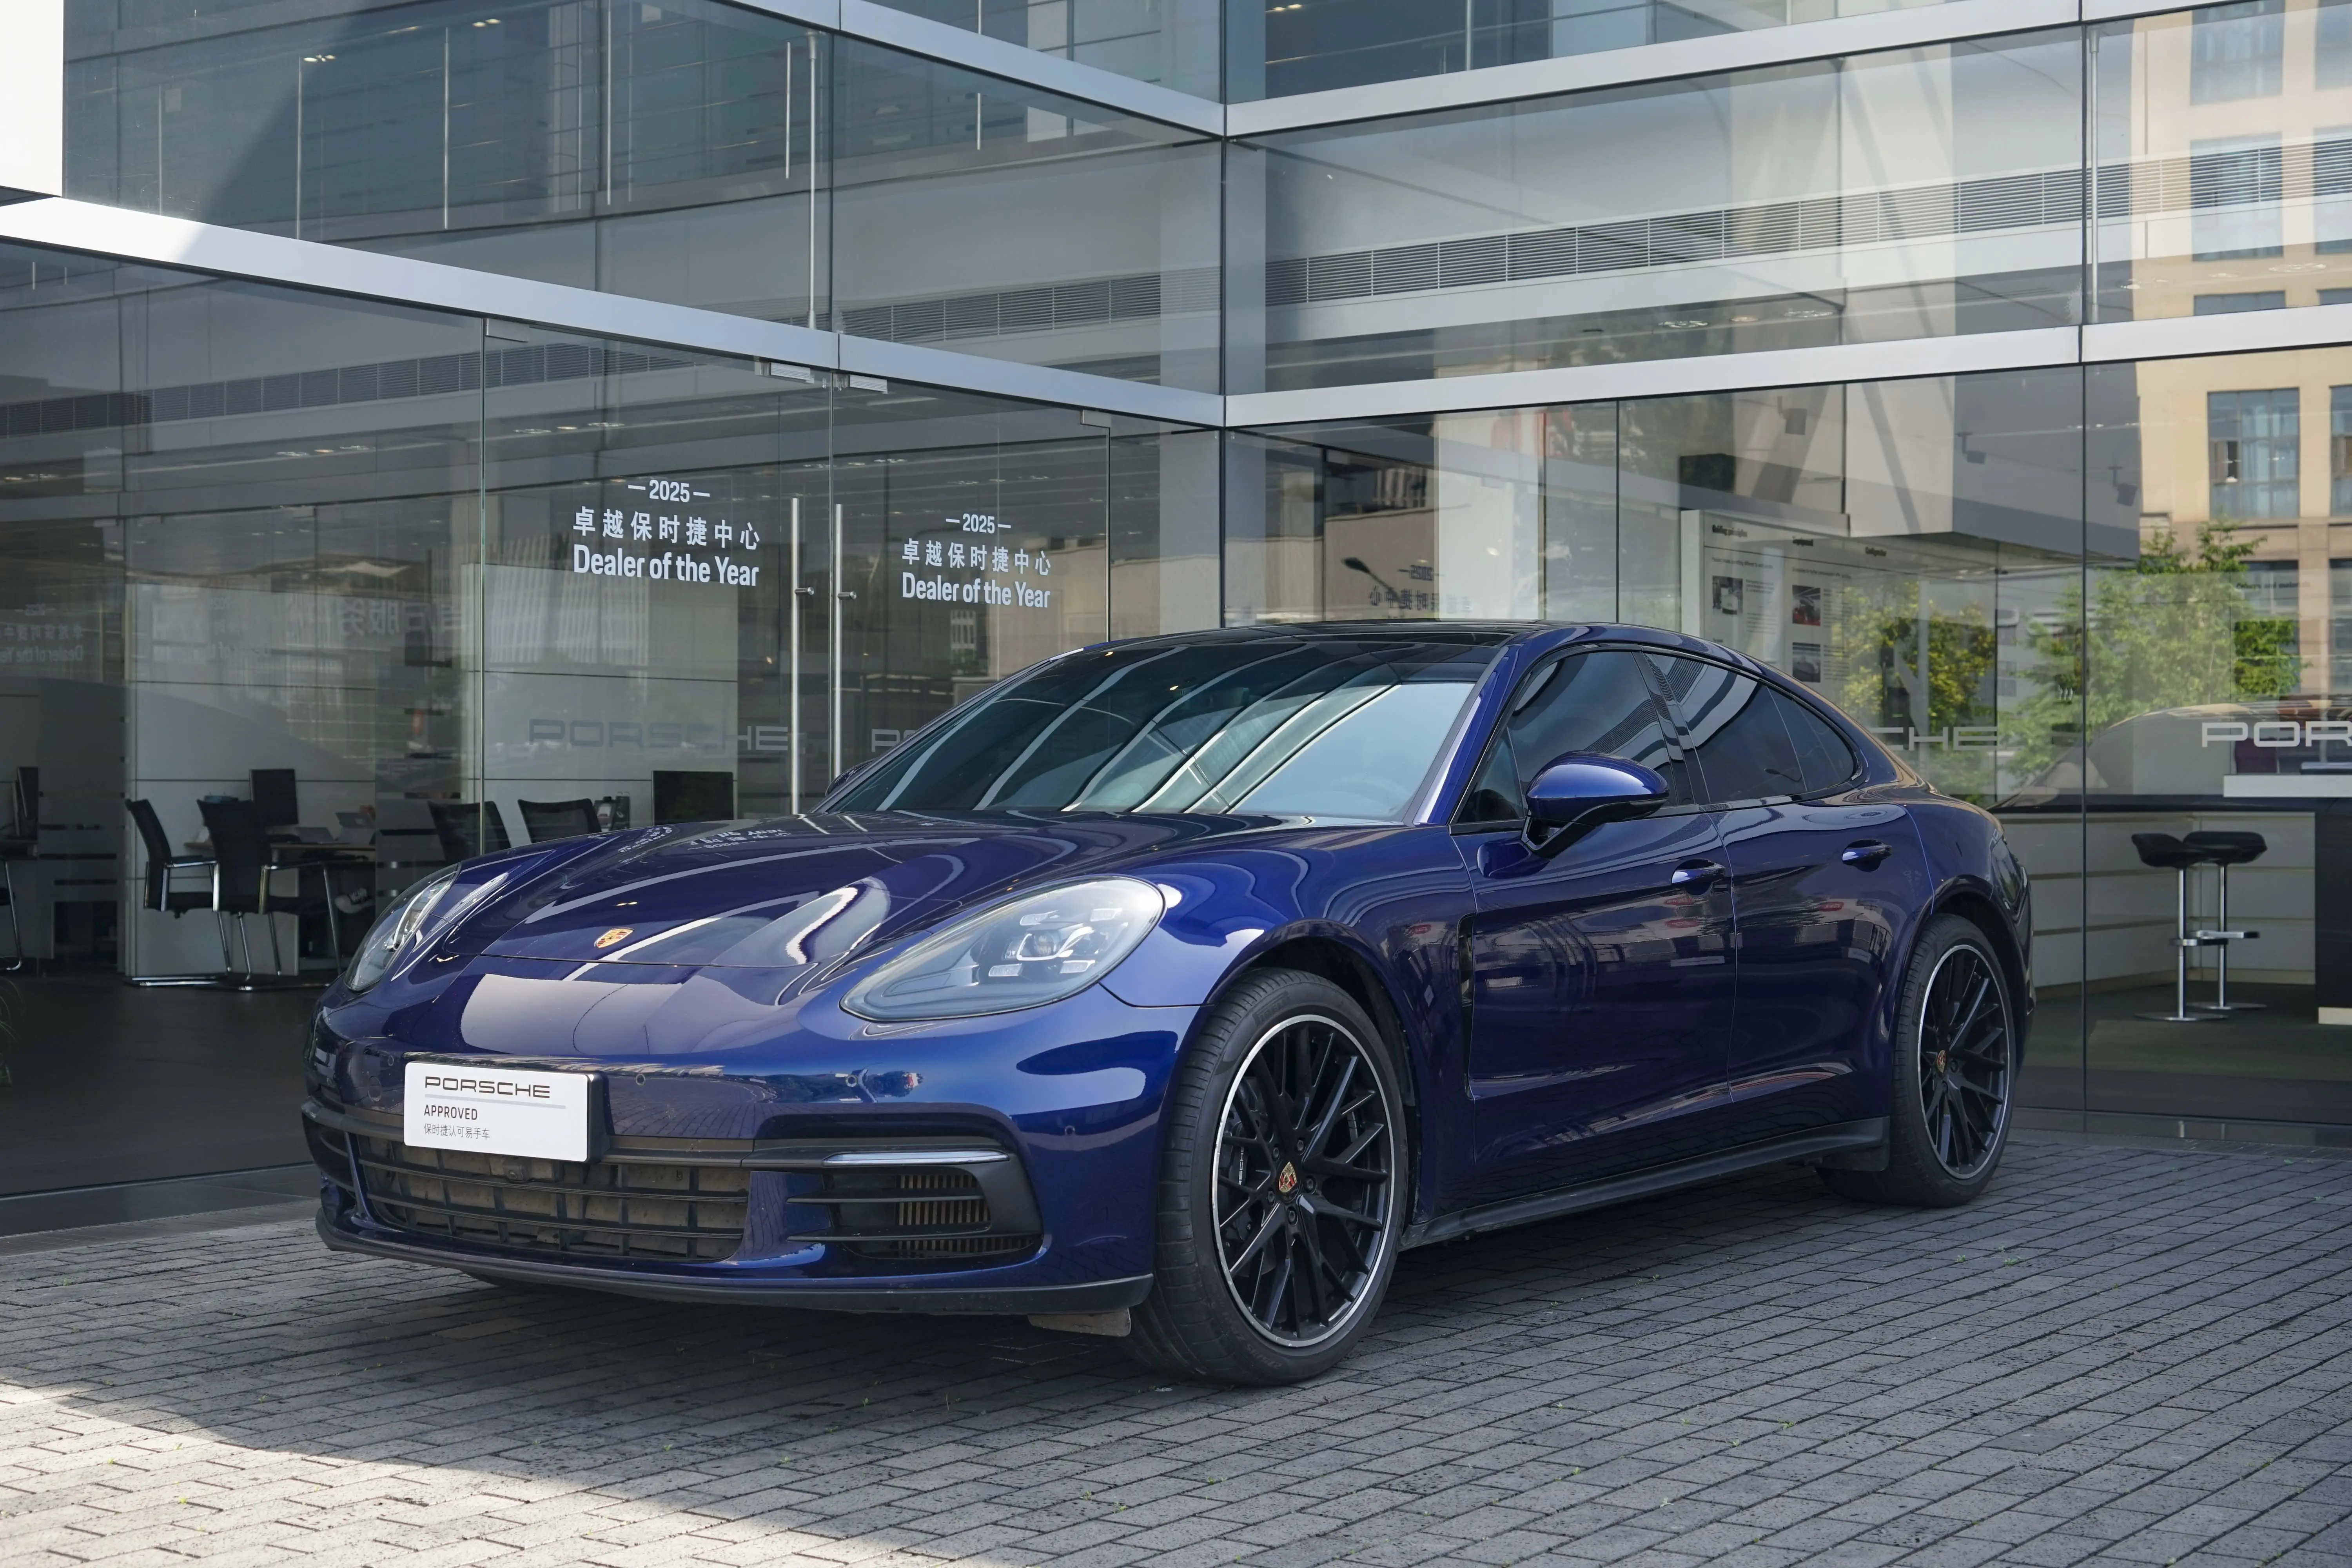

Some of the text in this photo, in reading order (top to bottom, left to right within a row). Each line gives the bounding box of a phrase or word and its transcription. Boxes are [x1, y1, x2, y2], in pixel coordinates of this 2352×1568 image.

[573, 506, 760, 550] 卓越保时捷中心
[574, 544, 759, 586] Dealer of the Year
[902, 538, 1051, 575] 卓越保时捷中心
[902, 572, 1050, 608] Dealer of the Year
[425, 1076, 550, 1098] PORSCHE
[424, 1104, 478, 1120] APPROVED
[423, 1122, 490, 1140] 保时捷认可易手车
